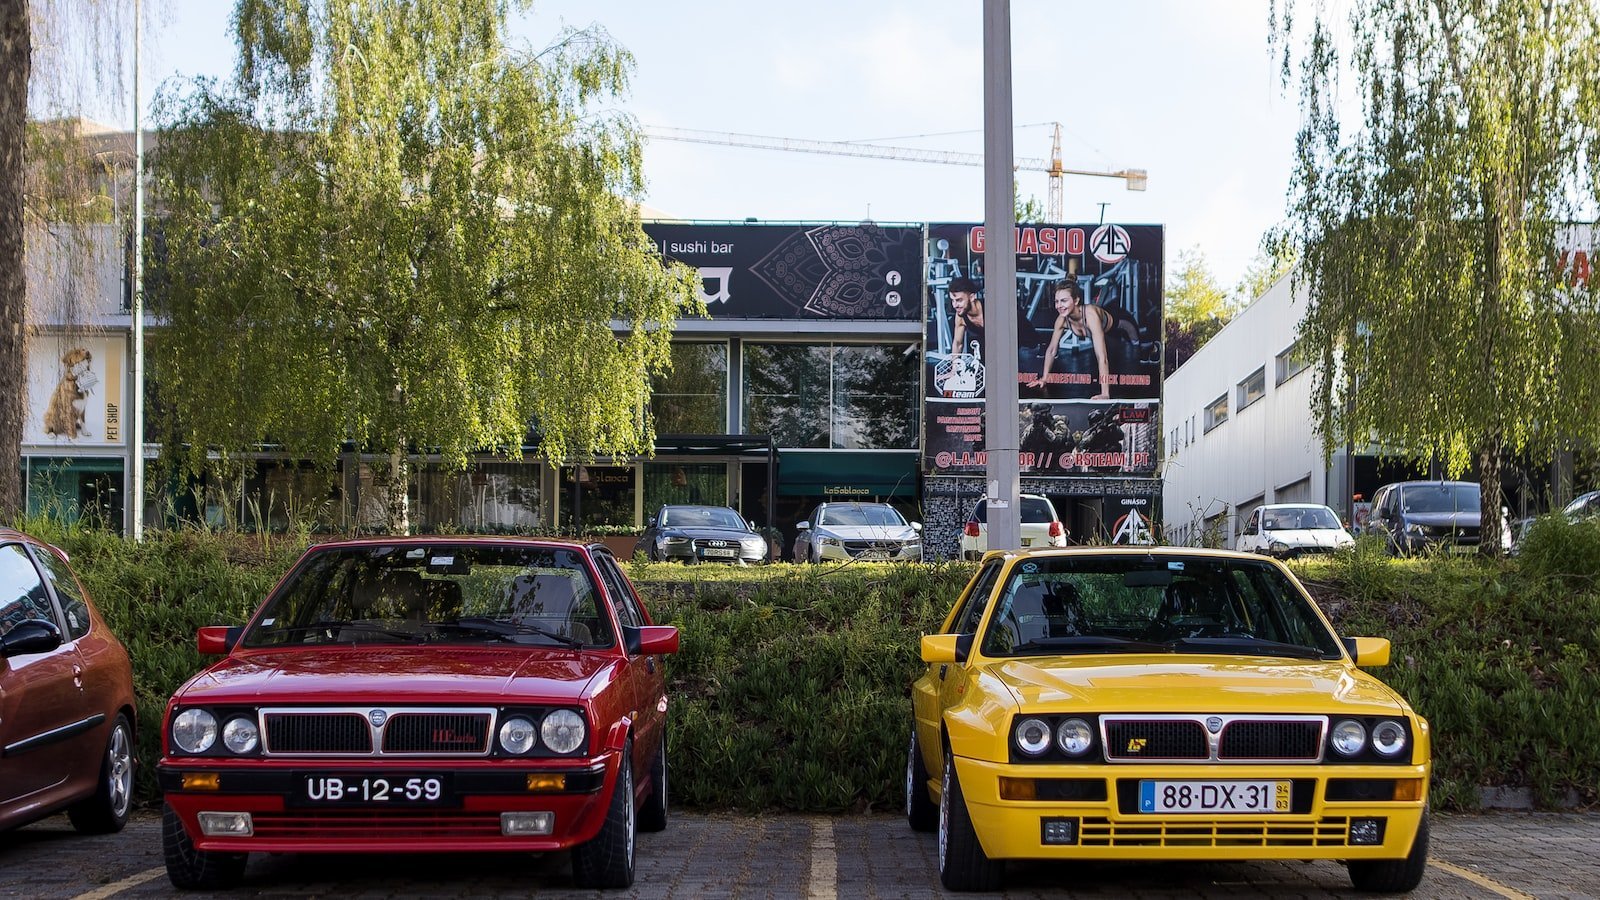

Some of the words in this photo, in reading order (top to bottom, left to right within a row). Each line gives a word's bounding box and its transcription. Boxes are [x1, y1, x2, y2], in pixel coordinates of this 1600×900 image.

[670, 241, 707, 254] sushi
[711, 241, 734, 254] bar
[970, 226, 1085, 255] GASIO
[106, 402, 118, 423] SHOP
[1122, 411, 1146, 419] LAW
[106, 426, 118, 440] PET
[307, 778, 441, 801] UB-12-59
[1275, 800, 1289, 809] 03
